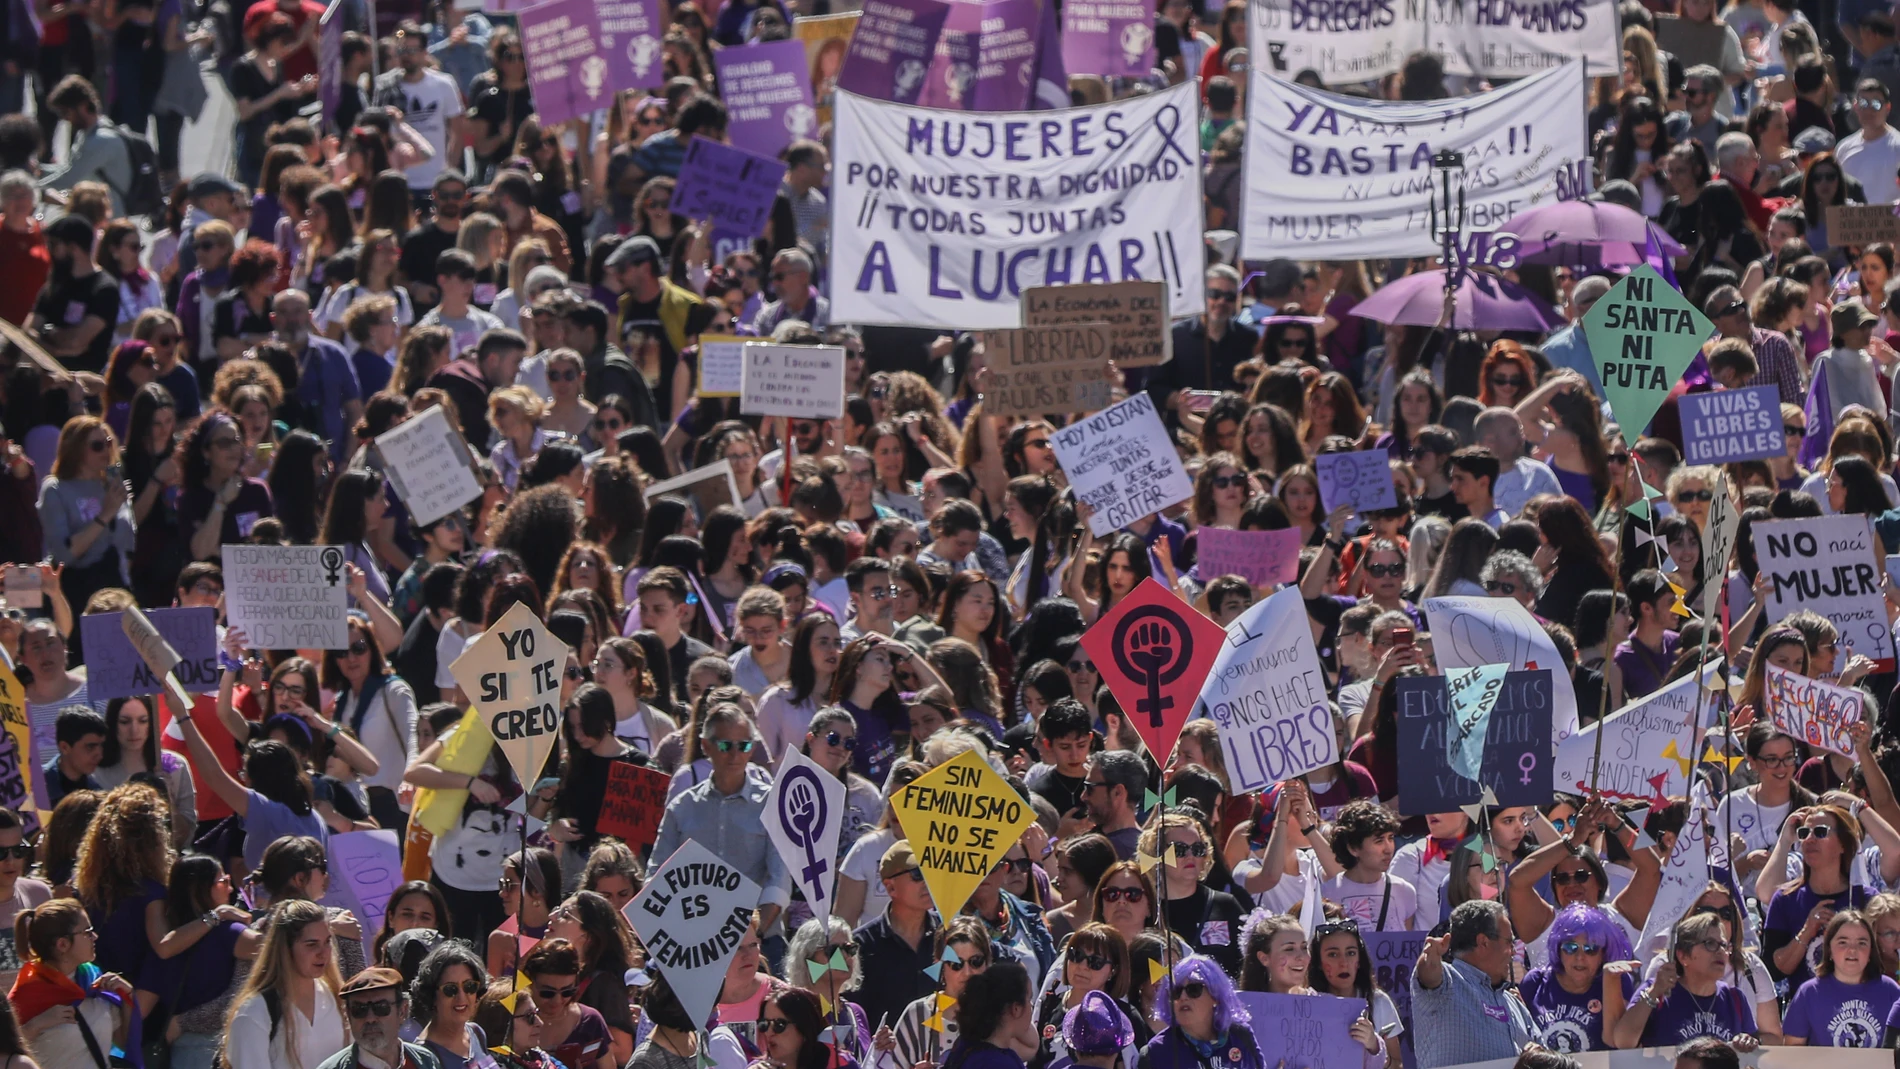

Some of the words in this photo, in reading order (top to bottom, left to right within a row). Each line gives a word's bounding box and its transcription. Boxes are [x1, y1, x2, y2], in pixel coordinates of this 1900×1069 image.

[1477, 0, 1587, 32] HUMANOS
[906, 112, 1128, 161] MUJERES
[847, 163, 899, 190] POR
[911, 174, 1041, 200] NUESTRA
[1007, 200, 1126, 234] JUNTAS
[1266, 213, 1364, 241] MUJER
[1407, 199, 1521, 232] HMBRE
[856, 241, 897, 293] A
[1626, 276, 1653, 302] NI
[1604, 304, 1696, 335] SANTA
[753, 355, 771, 366] LA
[1010, 328, 1105, 366] LIBERTAD
[1621, 335, 1653, 360] NI
[1602, 362, 1669, 391] PUTA
[1698, 391, 1760, 417] VIVAS
[1055, 425, 1085, 451] HOY
[1087, 416, 1107, 436] NO
[1694, 410, 1772, 438] LIBRES
[1691, 431, 1782, 460] IGUALES
[1109, 447, 1152, 476] JUNTAS
[1123, 458, 1159, 486] DESDE
[1106, 485, 1169, 530] GRITAR
[233, 549, 248, 565] OS
[250, 549, 265, 565] DA
[295, 550, 318, 565] ASCO
[1767, 532, 1818, 559] NO
[1829, 531, 1867, 552] nací
[234, 568, 250, 583] LA
[250, 568, 288, 584] SANGRE
[290, 569, 305, 584] DE
[307, 569, 323, 584] LA
[1772, 563, 1876, 604] MUJER
[237, 586, 273, 602] REGLA
[273, 587, 293, 603] QUE
[294, 587, 309, 602] LA
[310, 586, 331, 602] QUE
[237, 605, 303, 620] DERRAMAMOS
[303, 605, 341, 621] CUANDO
[1827, 606, 1875, 624] morir
[281, 624, 336, 646] MATAN
[498, 628, 535, 660] YO
[1227, 621, 1263, 648] EL
[1211, 636, 1302, 695] feminismo
[480, 672, 508, 703] SI
[531, 659, 559, 694] TE
[1448, 666, 1484, 698] ERTE
[1230, 690, 1272, 729] NOS
[1271, 670, 1321, 715] HACE
[1768, 670, 1797, 707] ME
[1804, 685, 1859, 727] CAGO
[491, 703, 557, 741] CREO
[1772, 698, 1805, 740] EN
[1229, 705, 1331, 790] LIBRES
[1616, 727, 1646, 760] SÍ
[944, 765, 982, 788] SIN
[1585, 757, 1673, 798] PANDEMA
[602, 800, 646, 827] MAÑANA
[903, 785, 1021, 824] FEMINISMO
[928, 821, 959, 845] NO
[965, 827, 999, 850] SE
[643, 889, 672, 917] EL
[664, 863, 741, 894] FUTURO
[681, 894, 710, 920] ES
[646, 905, 755, 970] FEMINISTA
[1293, 998, 1312, 1018] NO
[1841, 999, 1868, 1012] JUNTAS
[1281, 1017, 1323, 1039] QUIERO
[1827, 1009, 1855, 1031] HACEMOS
[1856, 1009, 1882, 1032] HISTORIA
[1286, 1037, 1322, 1057] PUEDO
